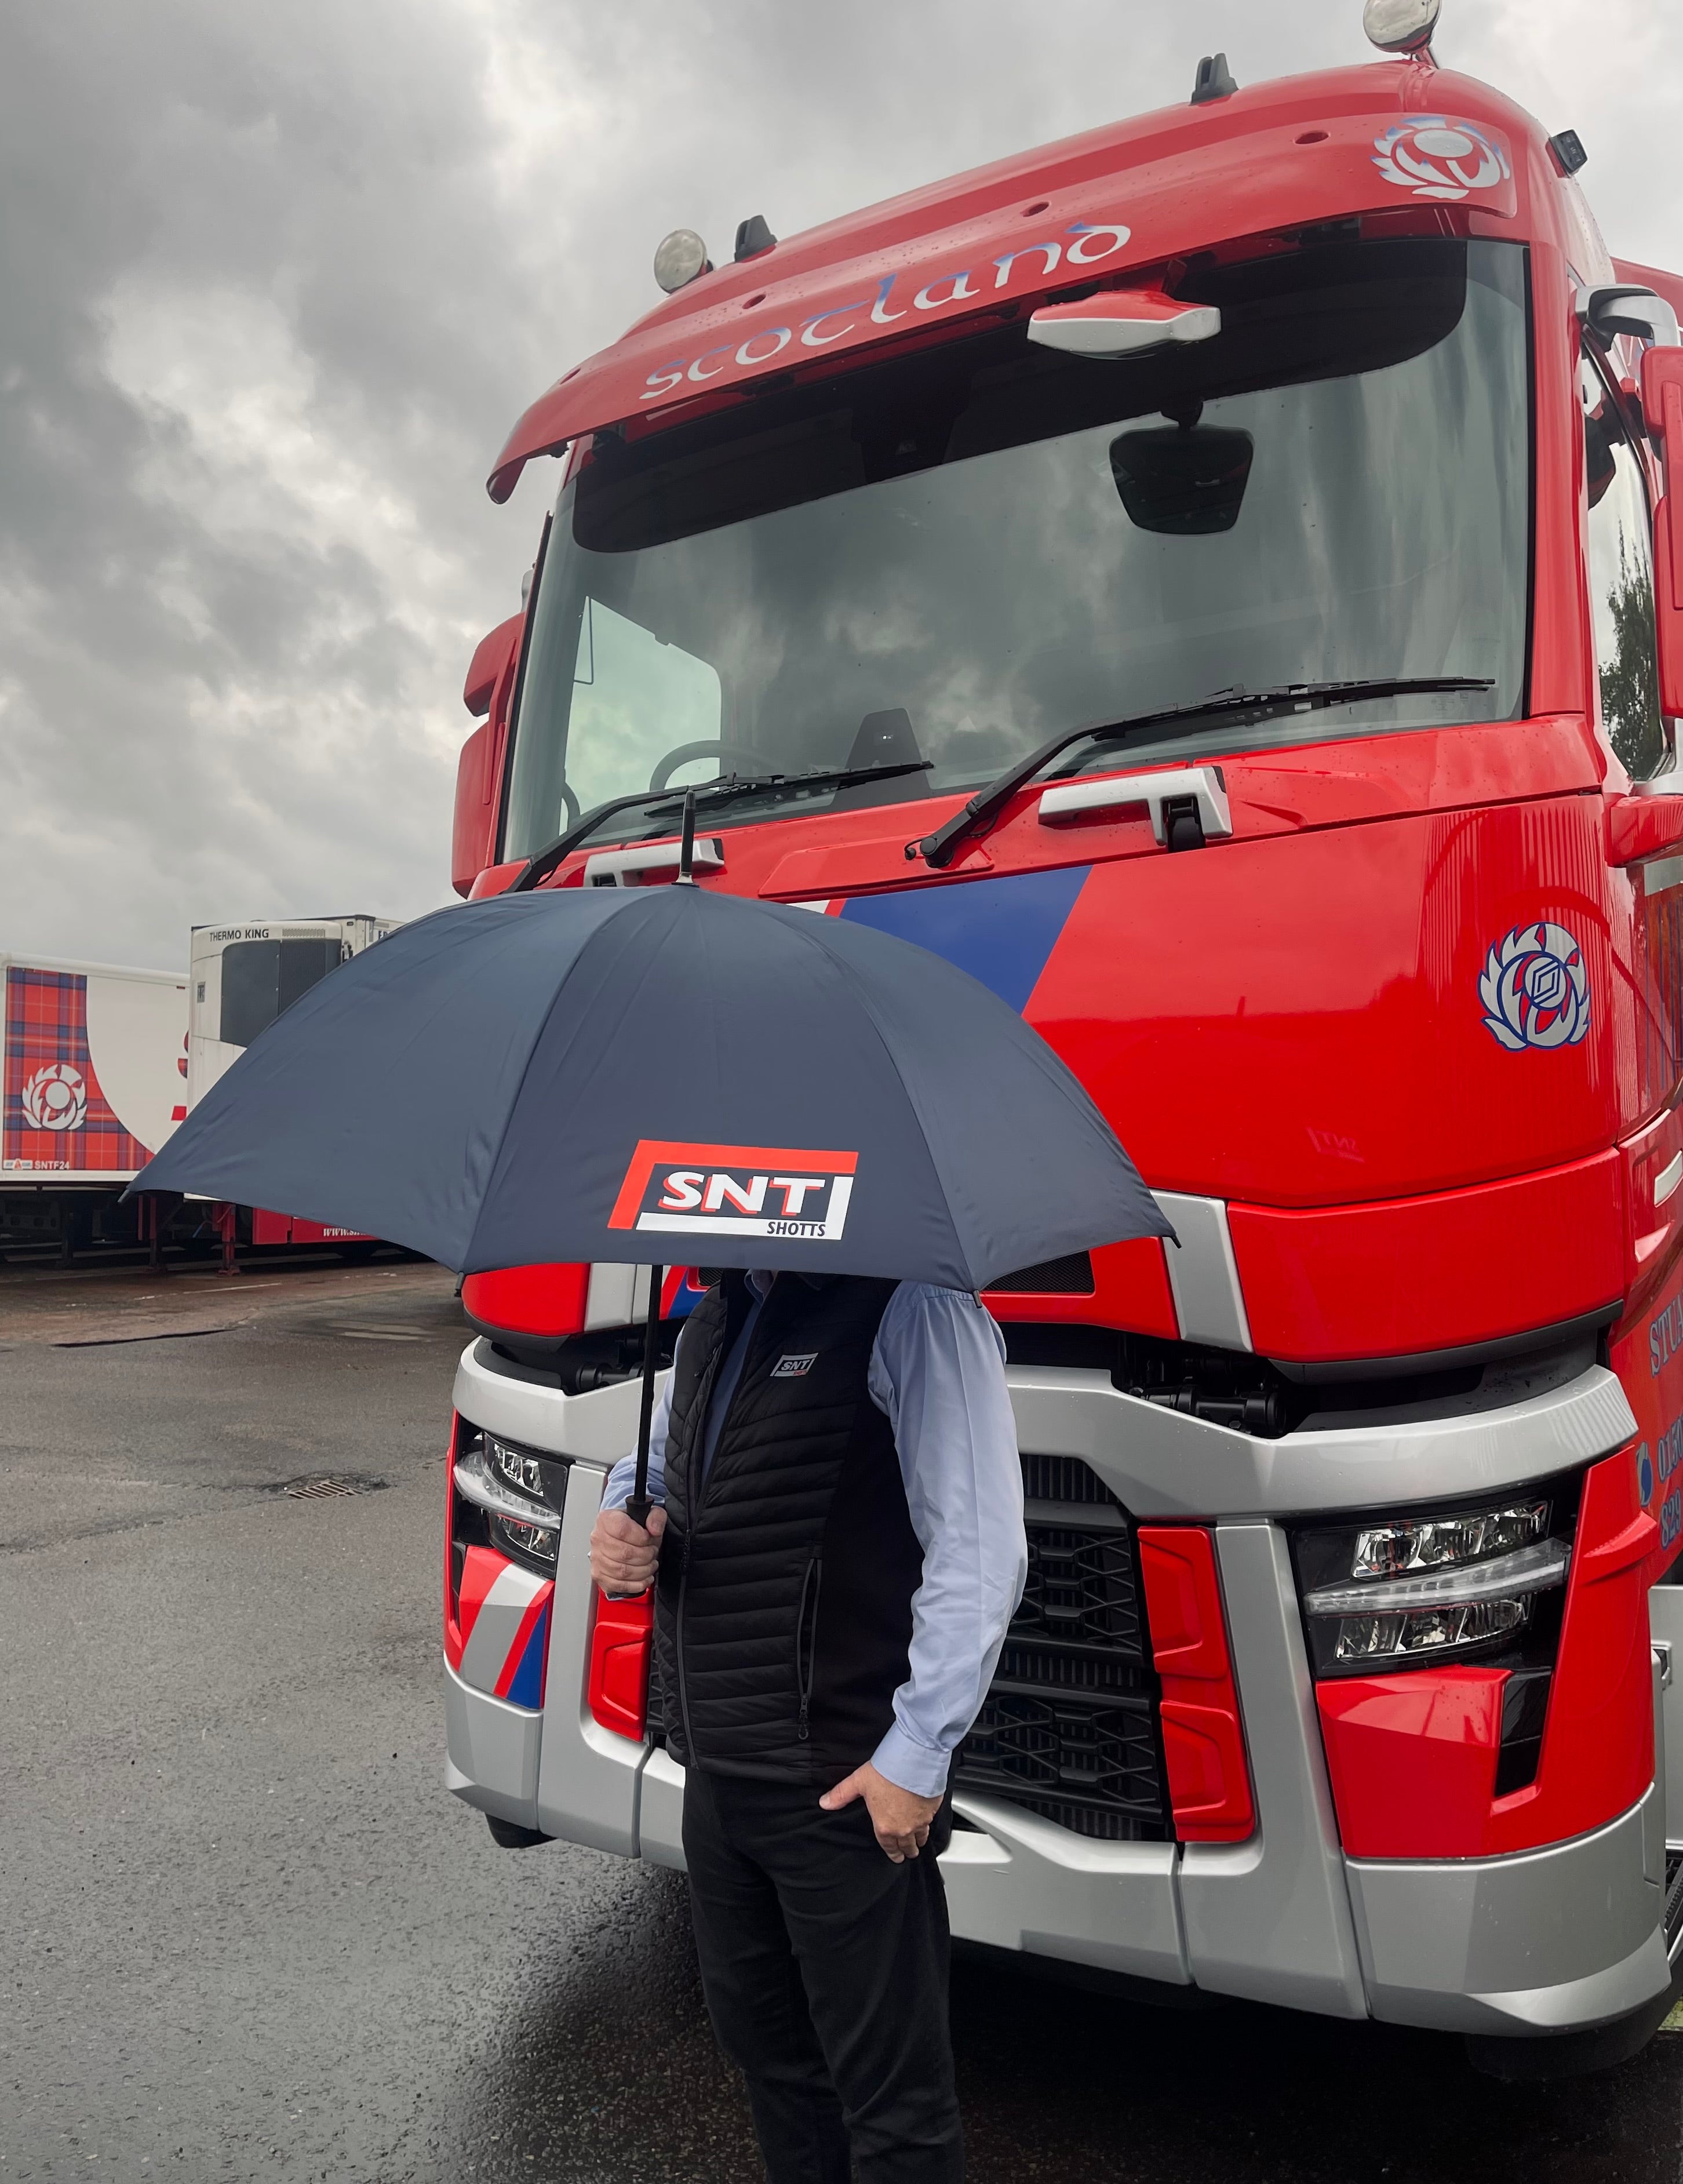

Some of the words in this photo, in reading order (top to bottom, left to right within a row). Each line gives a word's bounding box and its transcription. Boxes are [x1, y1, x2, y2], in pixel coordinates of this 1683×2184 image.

[209, 930, 242, 942] THERMO
[245, 929, 269, 939] KING
[35, 1160, 70, 1170] SNTF24
[658, 1171, 826, 1216] SNT
[767, 1221, 826, 1237] SHOTTS
[1650, 1289, 1683, 1378] STUA
[781, 1360, 810, 1371] SNT
